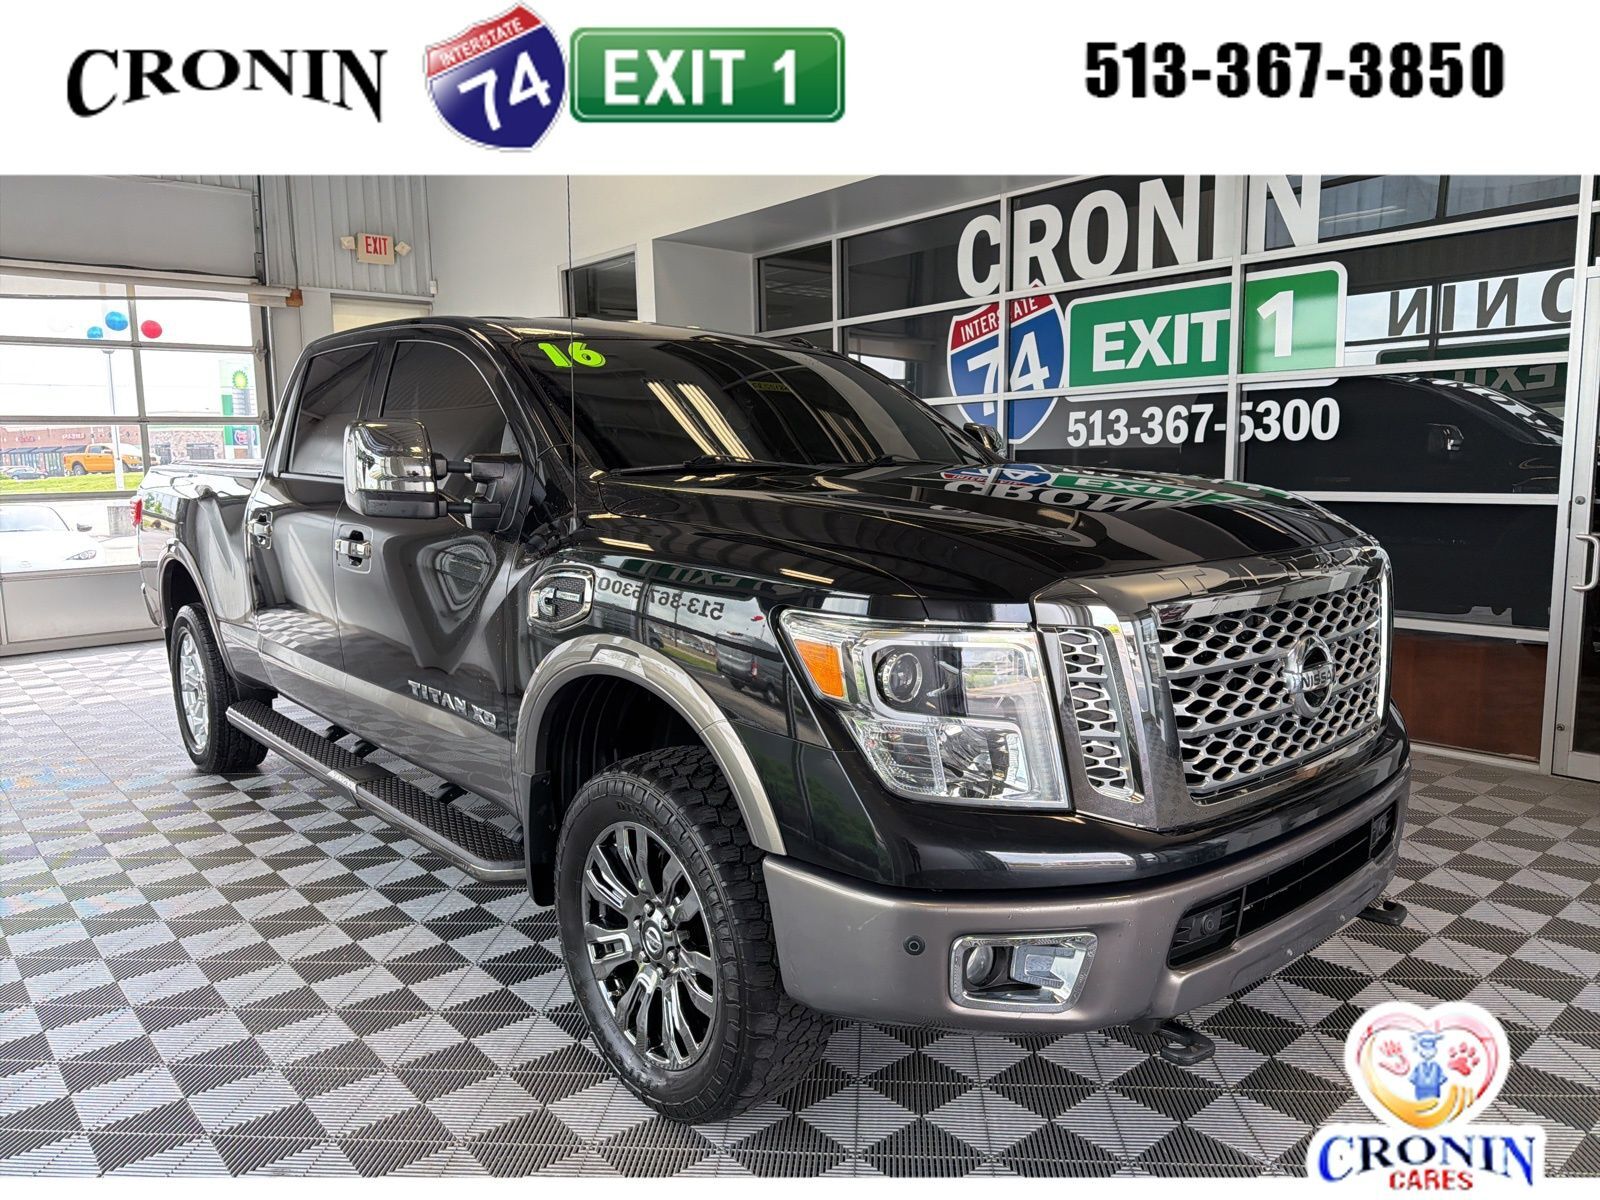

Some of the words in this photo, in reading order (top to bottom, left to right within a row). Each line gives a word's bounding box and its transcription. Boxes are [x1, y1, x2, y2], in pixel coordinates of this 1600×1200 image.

[365, 235, 388, 255] EXIT
[957, 175, 1321, 297] CRONIN
[960, 295, 1038, 342] INTERATE
[1092, 309, 1230, 372] EXIT
[1256, 290, 1294, 358] 1
[538, 342, 606, 368] 16
[967, 330, 1050, 417] 74
[1067, 398, 1340, 448] 513-367-5300
[407, 679, 468, 716] TITAN
[1301, 669, 1334, 690] NISSA
